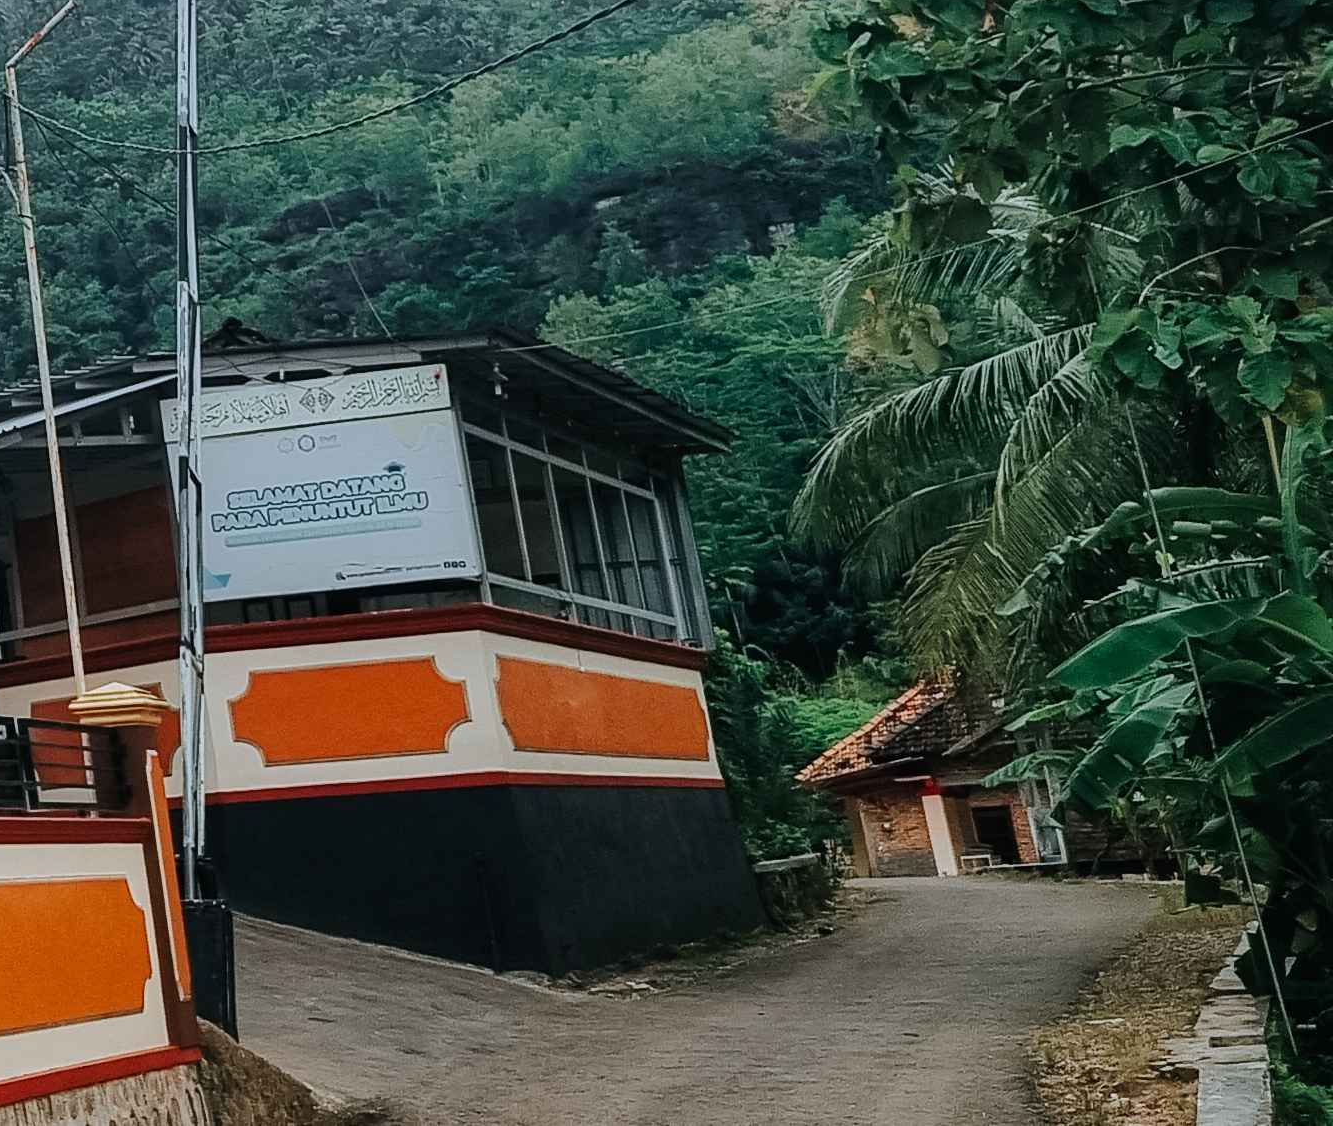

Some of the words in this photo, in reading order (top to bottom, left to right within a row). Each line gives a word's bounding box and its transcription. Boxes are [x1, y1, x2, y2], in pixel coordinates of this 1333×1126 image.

[320, 474, 406, 499] DATANG
[211, 510, 269, 532] PARA
[375, 491, 429, 515] ILMU
